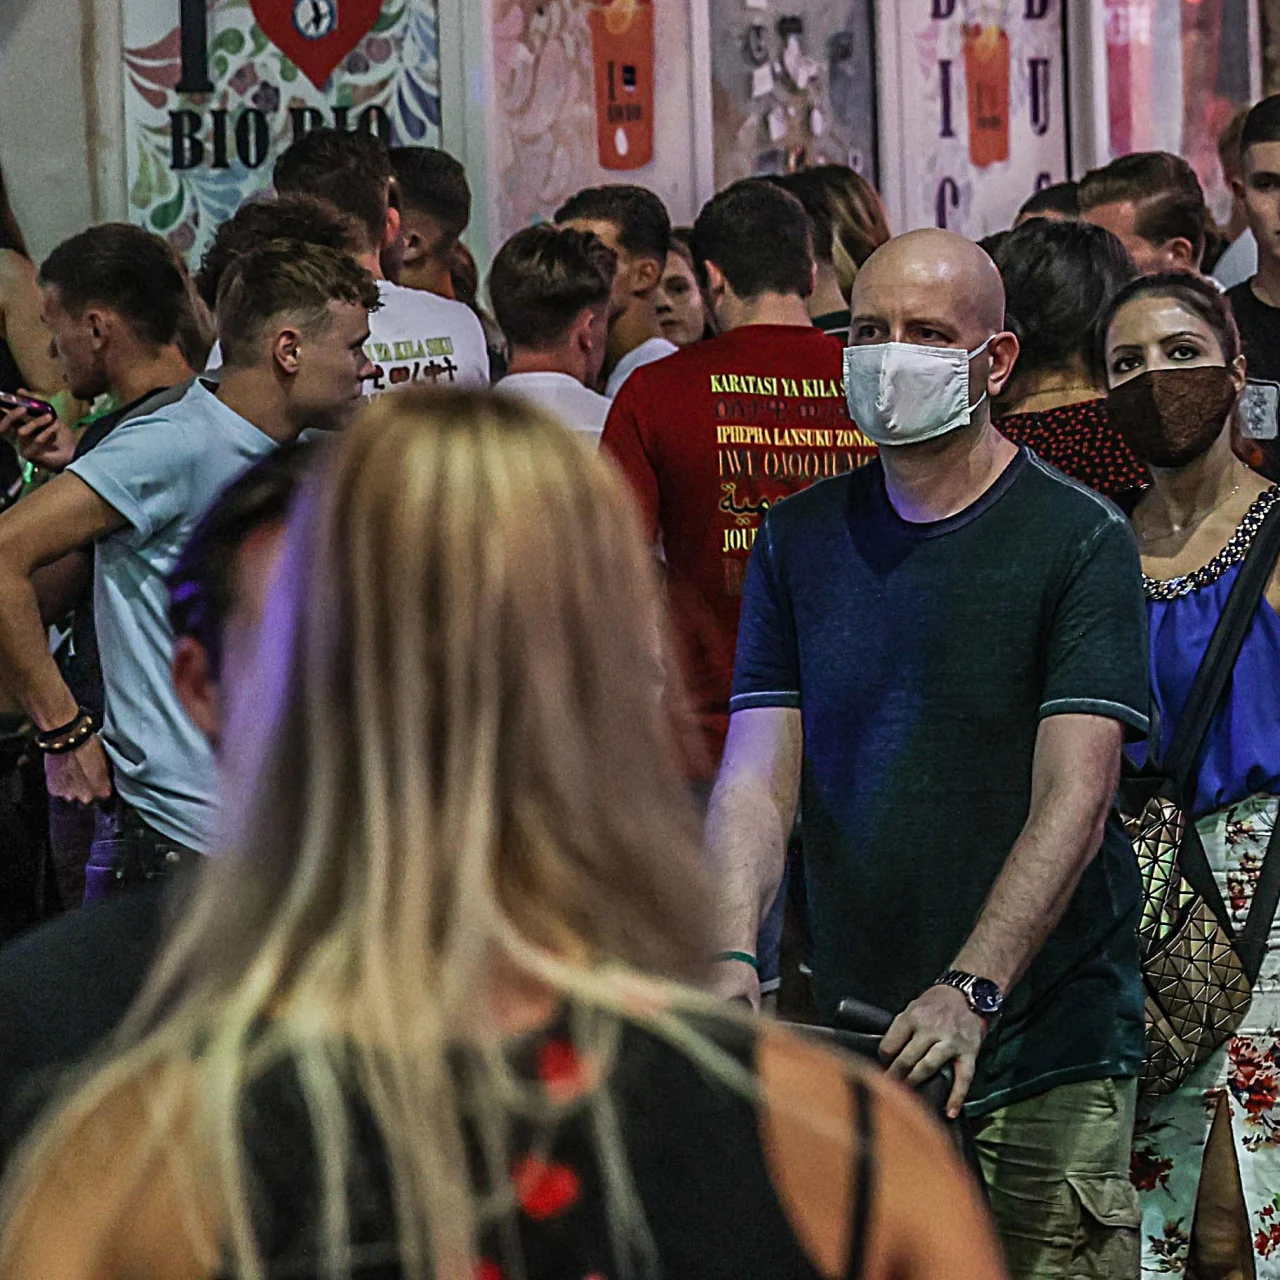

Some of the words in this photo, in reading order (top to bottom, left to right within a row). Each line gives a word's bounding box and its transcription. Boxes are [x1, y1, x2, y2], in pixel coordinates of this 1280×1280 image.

[169, 106, 270, 170] BIO
[710, 374, 778, 396] KARATASI
[781, 378, 799, 397] YA
[802, 379, 838, 398] KILA
[717, 425, 771, 445] IPHEPHA
[774, 427, 833, 447] LANSUKU
[836, 429, 878, 447] ZONK
